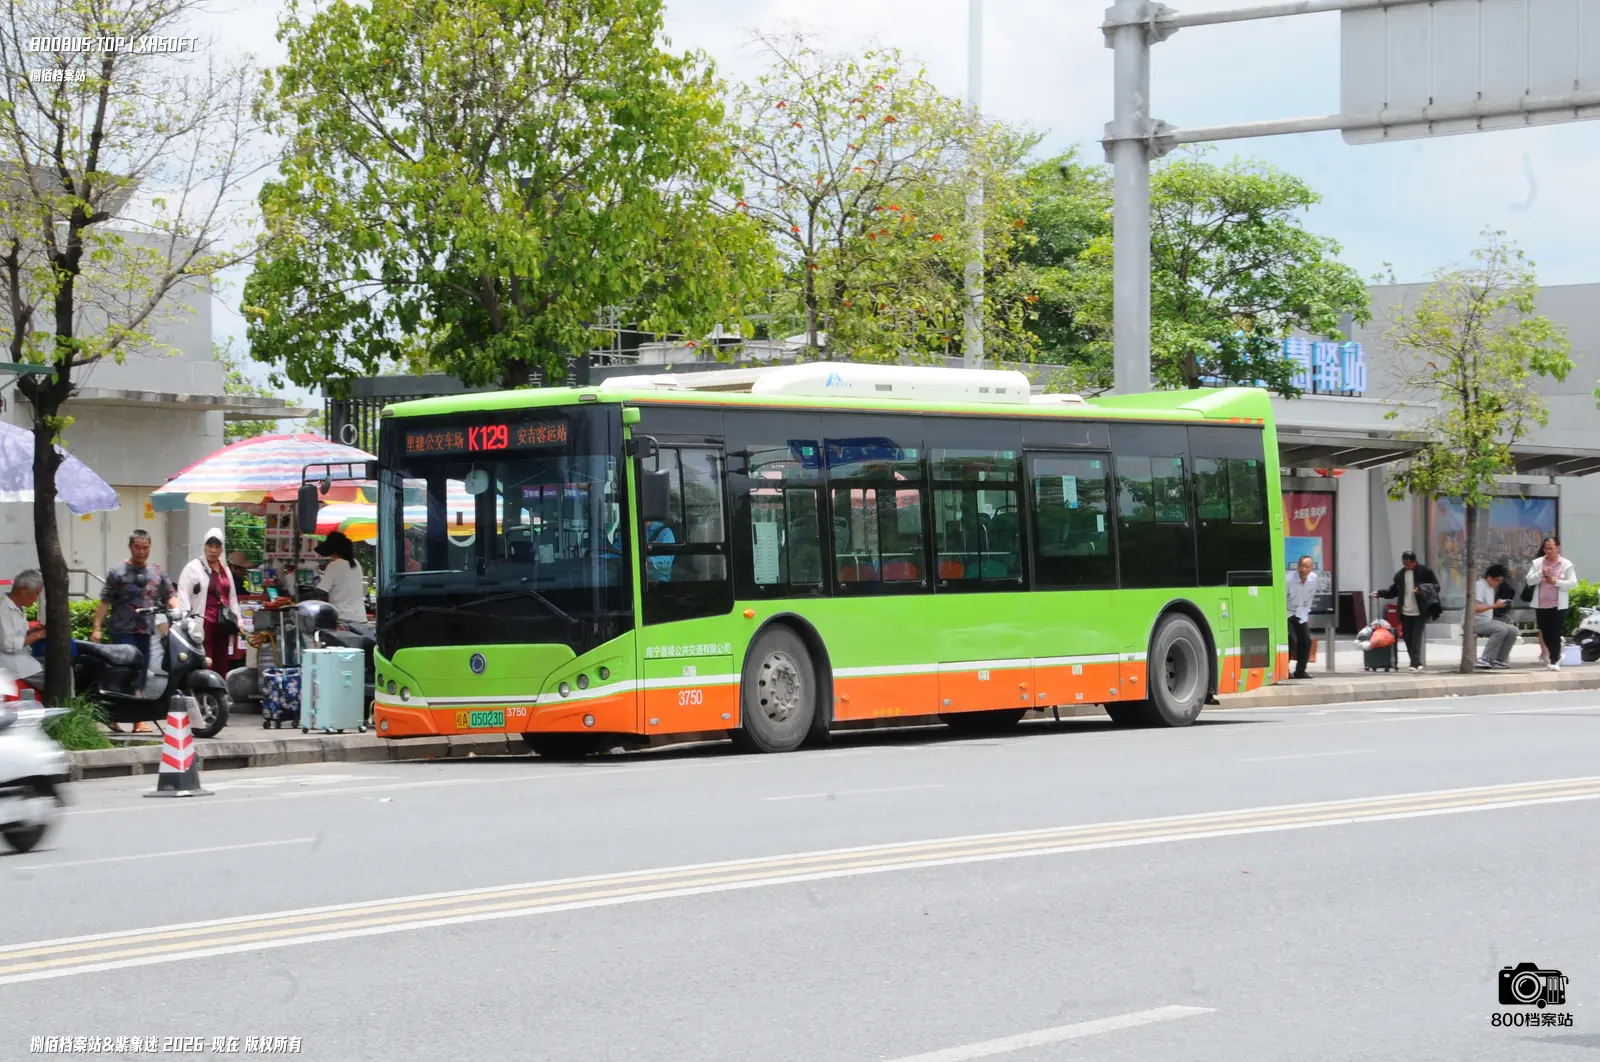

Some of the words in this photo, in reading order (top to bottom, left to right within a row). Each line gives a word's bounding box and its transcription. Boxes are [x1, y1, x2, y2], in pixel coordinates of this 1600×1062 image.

[468, 424, 509, 451] K129
[517, 423, 567, 446] 安吉客运站
[678, 689, 703, 706] 3750
[506, 706, 527, 717] 3750
